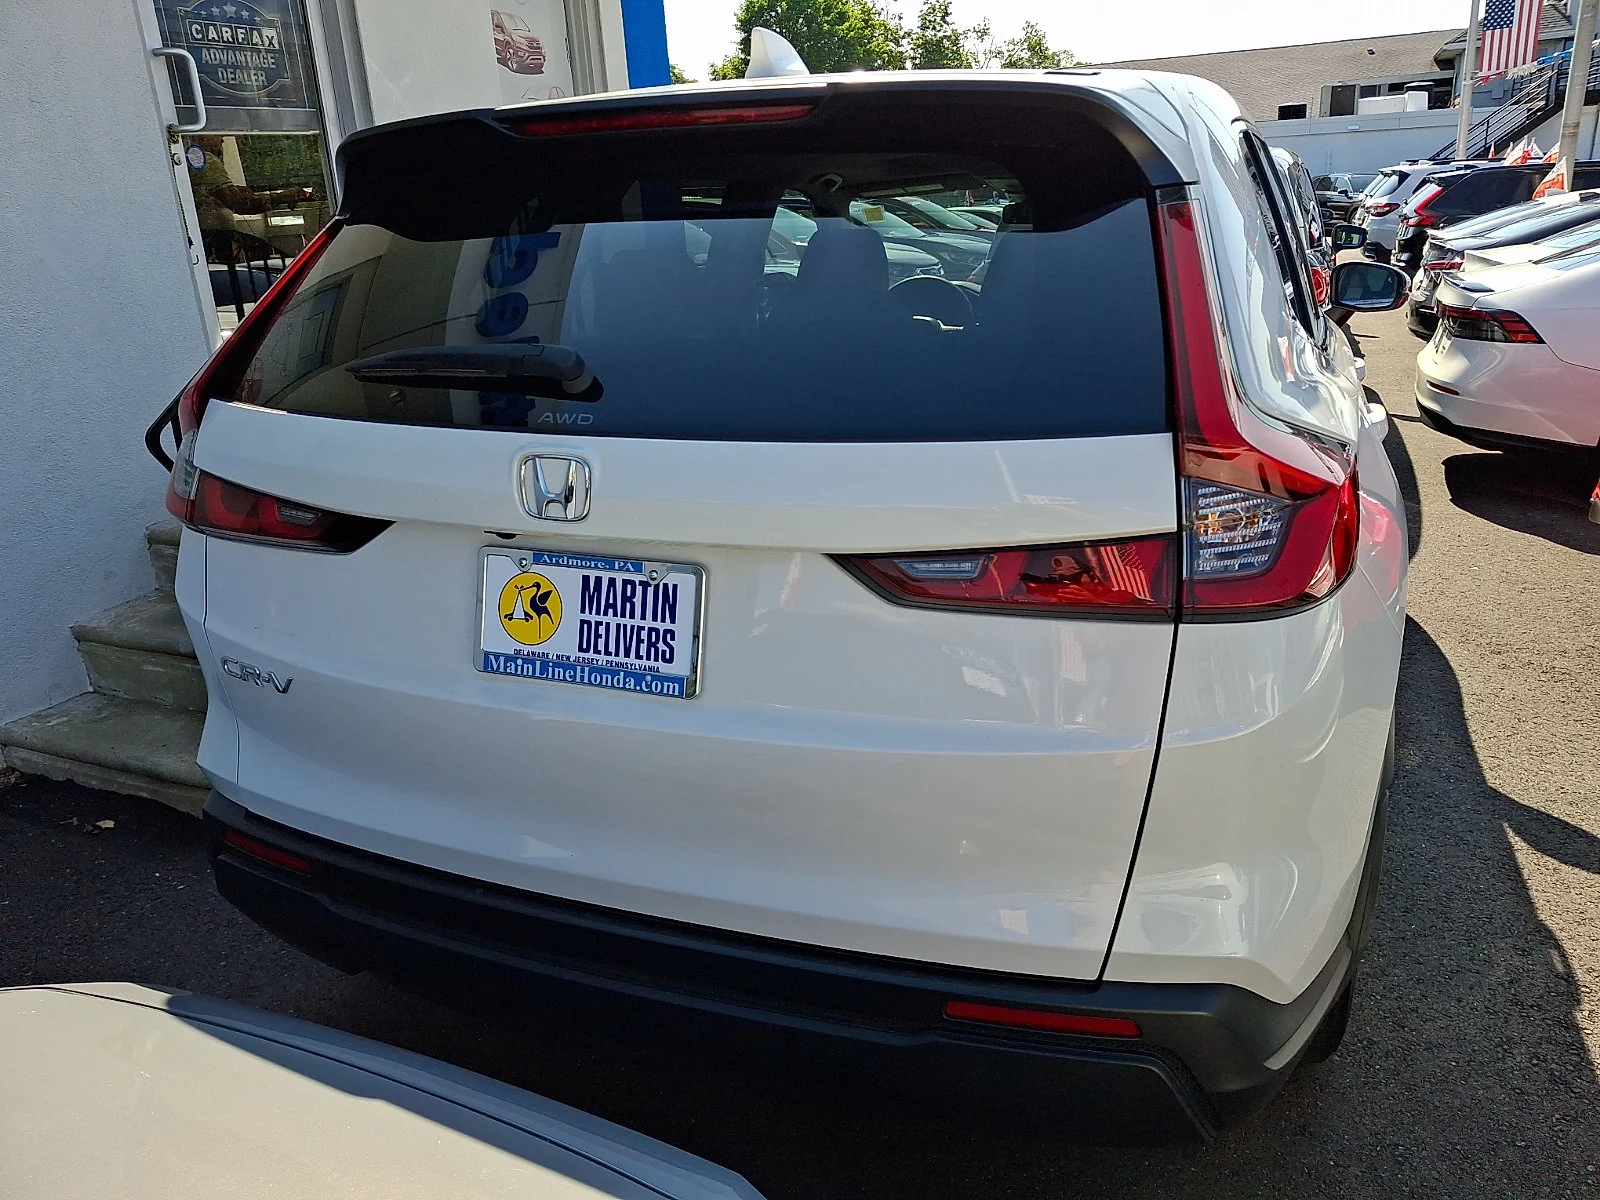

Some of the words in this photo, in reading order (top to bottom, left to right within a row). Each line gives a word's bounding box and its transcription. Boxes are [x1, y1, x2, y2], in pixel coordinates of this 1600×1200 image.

[191, 23, 277, 48] CARFAX
[201, 48, 277, 69] ADVANTAGE
[217, 67, 268, 86] DEALER
[537, 412, 594, 425] AWD
[540, 554, 610, 569] Ardmore,
[614, 560, 636, 572] PA
[580, 574, 678, 625] MARTIN
[577, 618, 676, 664] DELIVERS
[513, 648, 550, 660] DELAWARE
[556, 653, 573, 662] NEW
[573, 656, 600, 666] JERSEY
[605, 660, 661, 673] PENNSYLVANIA
[220, 655, 294, 694] CR-V
[487, 654, 680, 696] MainLineHonda.com
